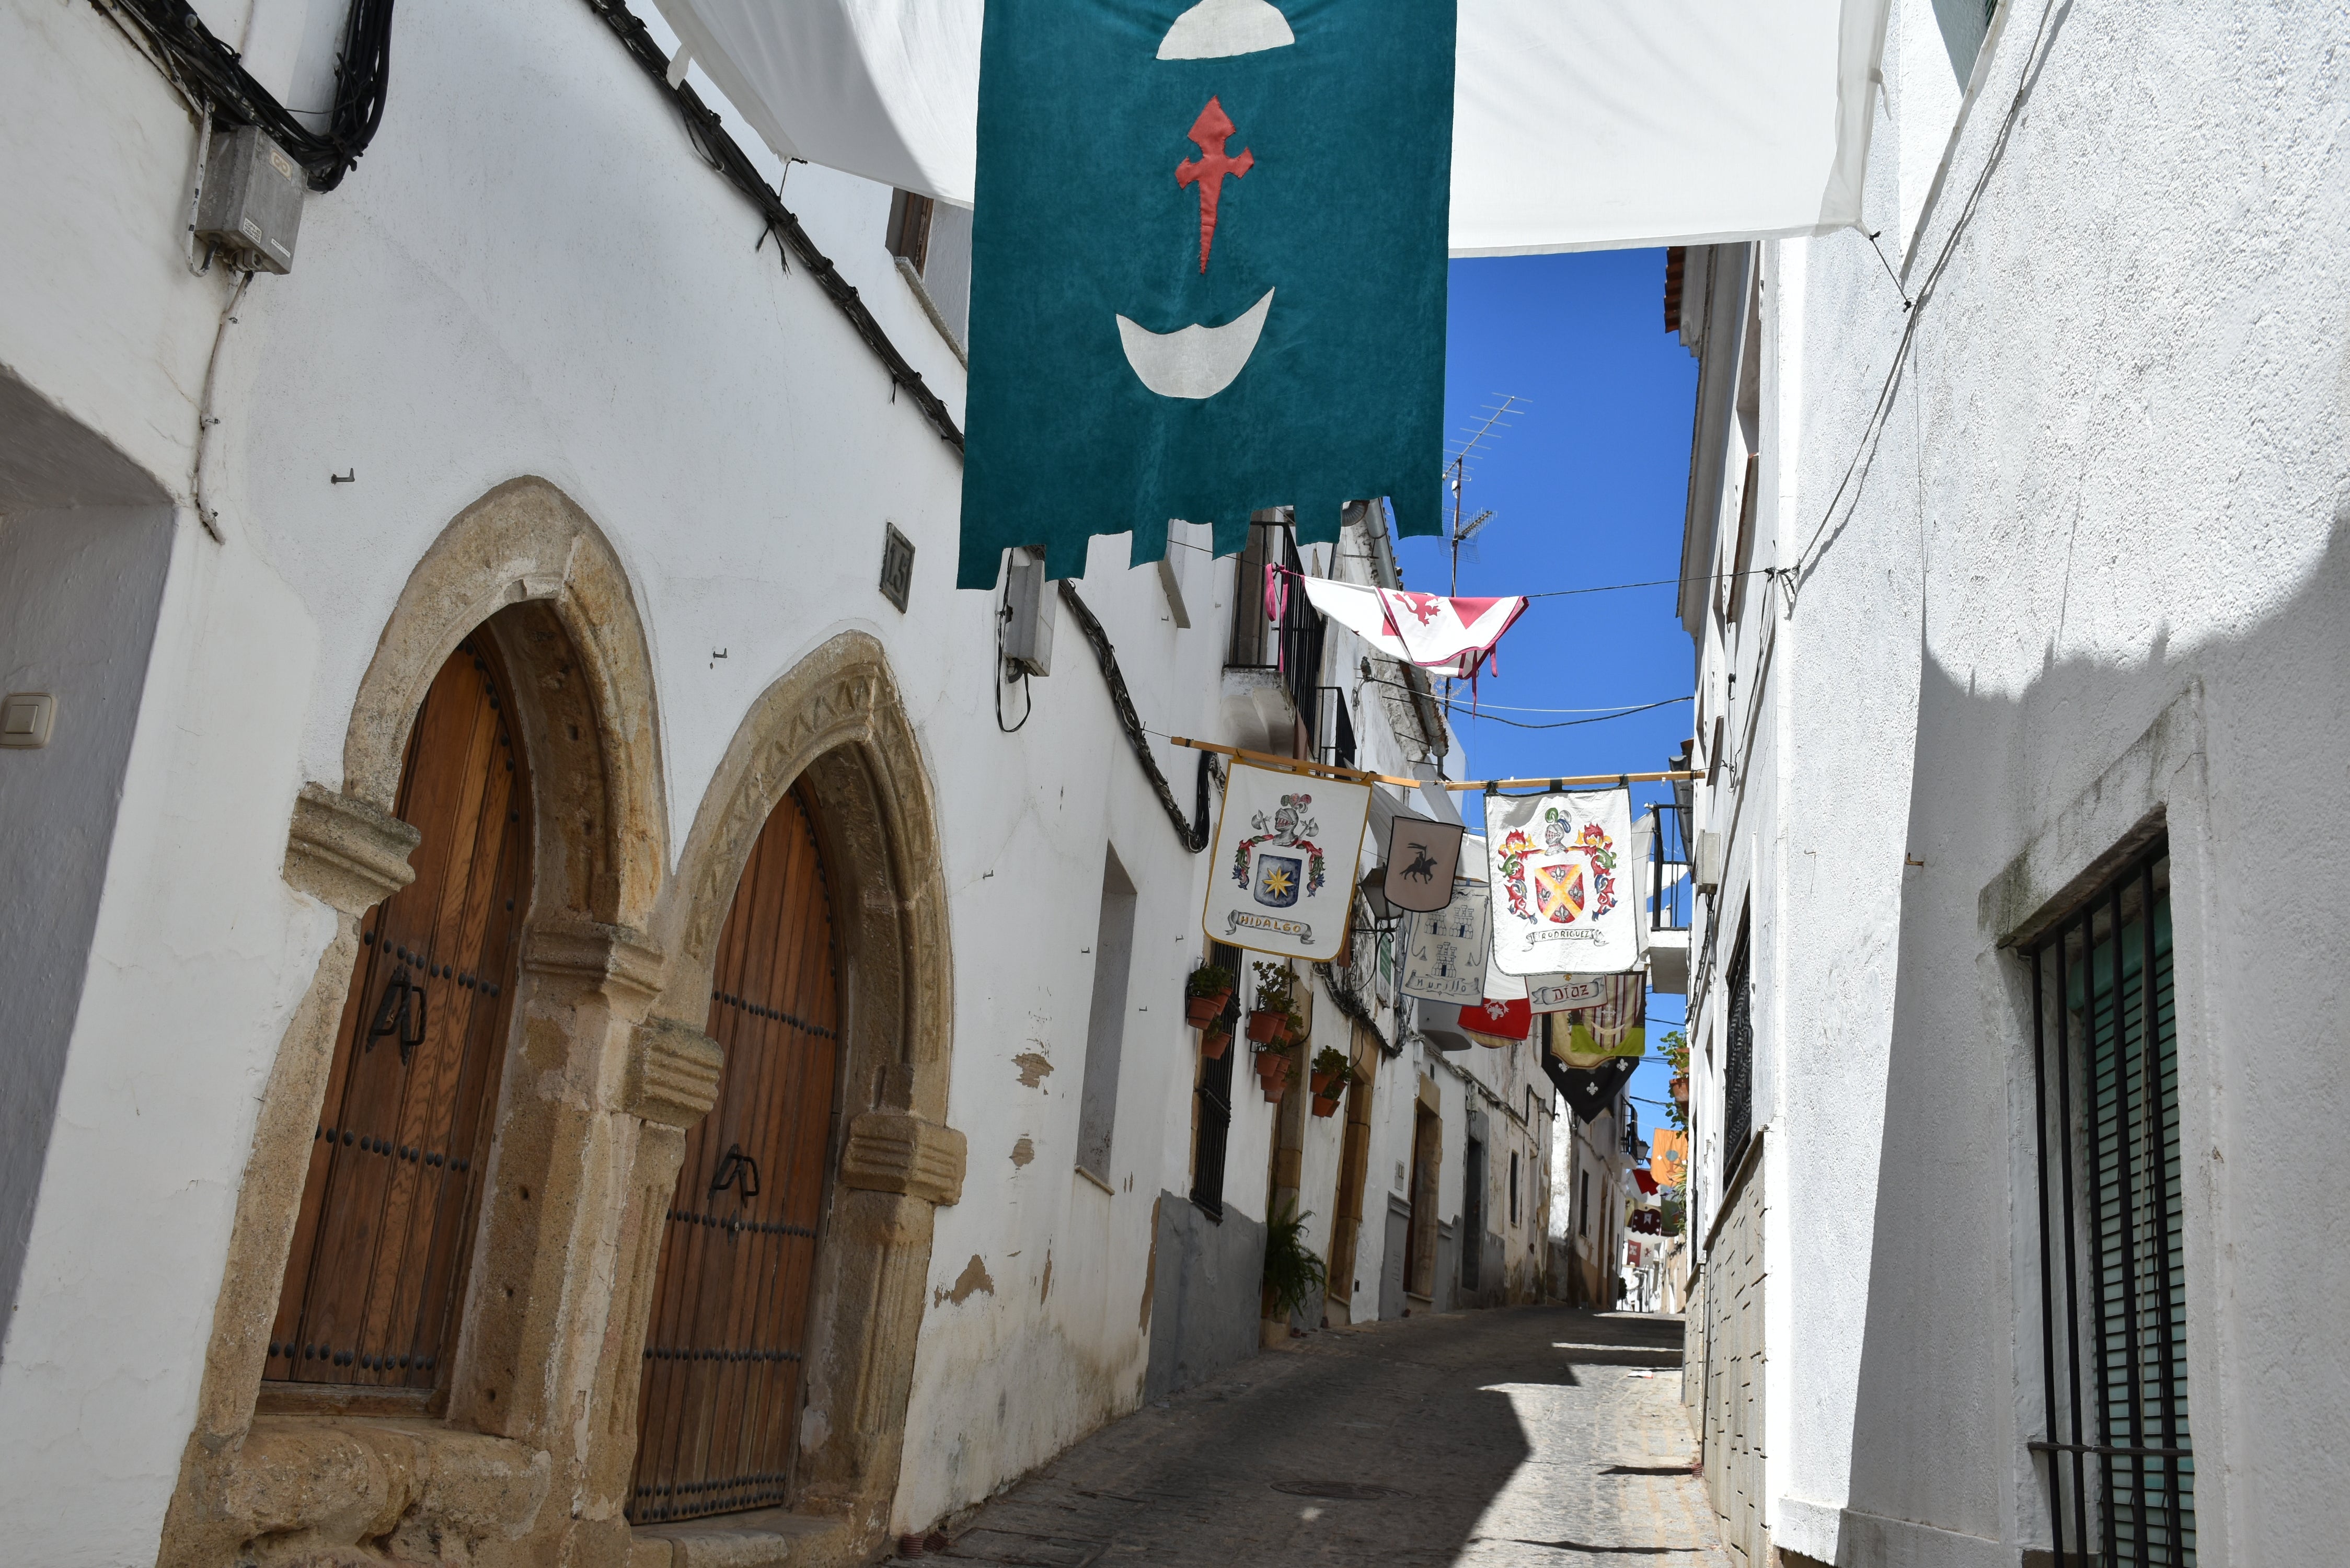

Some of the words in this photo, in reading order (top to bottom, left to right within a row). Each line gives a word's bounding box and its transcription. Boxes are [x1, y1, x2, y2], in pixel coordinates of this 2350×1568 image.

[887, 543, 909, 593] 15
[1240, 915, 1301, 933] HIDALGO
[1541, 930, 1589, 939] RODRIGUEZ
[1415, 978, 1466, 992] Murillo
[1552, 985, 1589, 1002] Díaz
